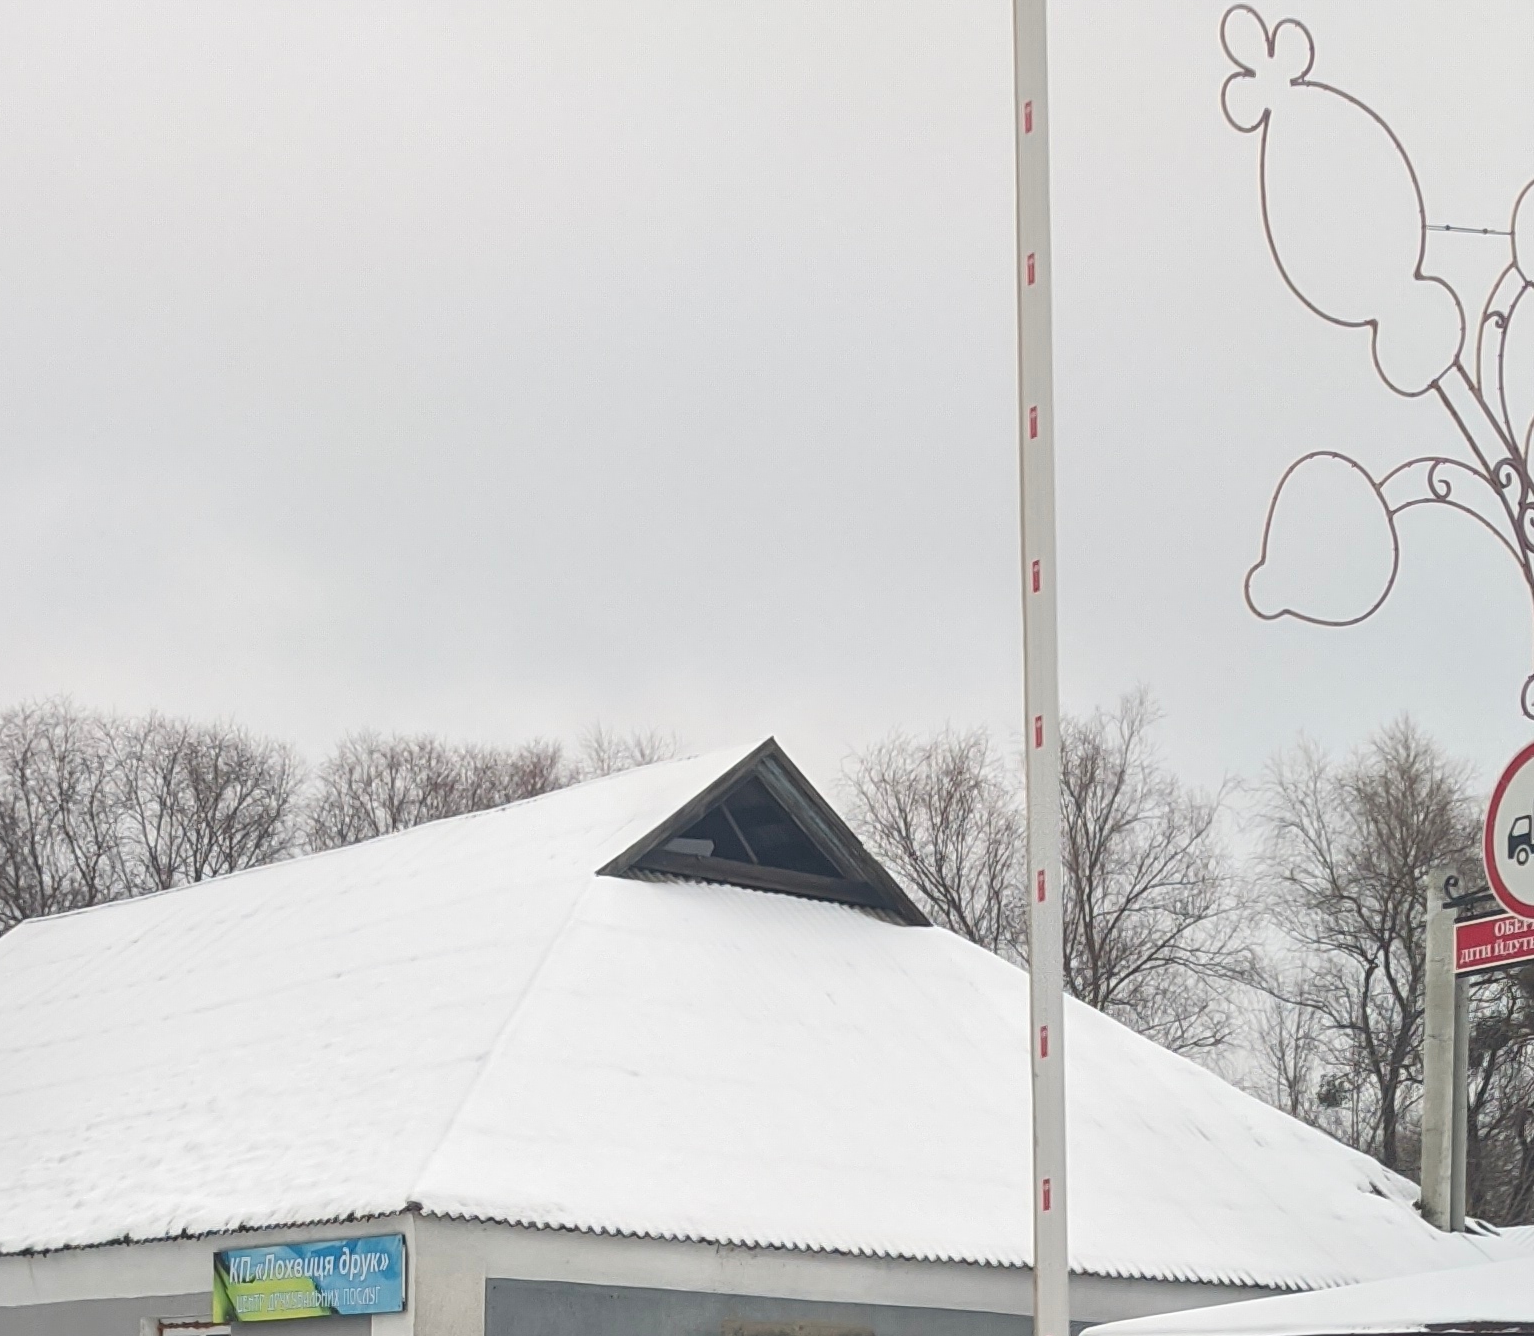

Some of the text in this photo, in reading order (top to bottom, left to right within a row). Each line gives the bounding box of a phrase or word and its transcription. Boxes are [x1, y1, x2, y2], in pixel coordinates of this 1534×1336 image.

[1460, 944, 1491, 964] ДІТИ
[229, 1256, 252, 1284] КП
[338, 1246, 390, 1281] друк»
[236, 1293, 265, 1313] ЦЕНТР
